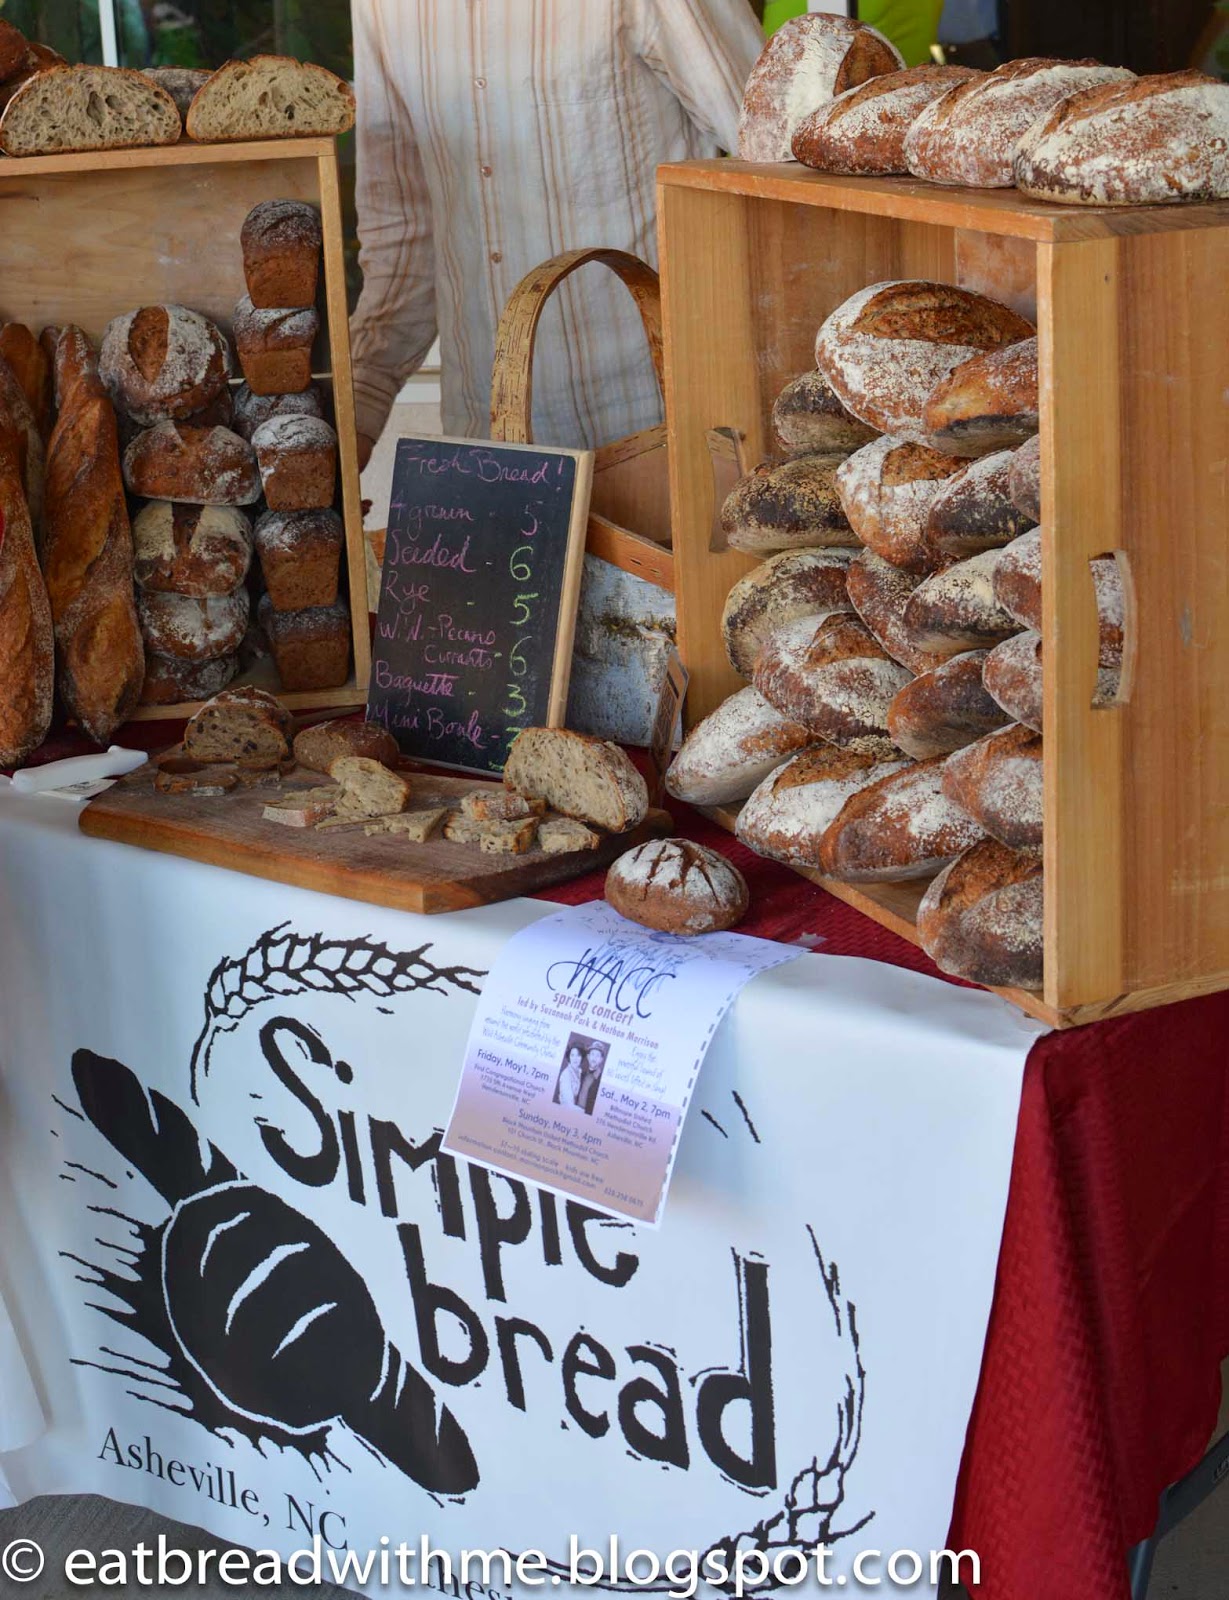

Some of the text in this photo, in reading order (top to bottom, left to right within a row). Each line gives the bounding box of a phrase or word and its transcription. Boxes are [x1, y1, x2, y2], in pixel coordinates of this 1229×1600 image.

[520, 501, 543, 536] 5
[389, 529, 477, 572] Seeded
[510, 546, 534, 581] 6
[386, 570, 430, 615] Rye
[510, 593, 539, 625] 5
[510, 636, 533, 676] 6
[375, 660, 460, 706] Baguette
[502, 683, 526, 717] 3
[547, 948, 676, 1018] WACC
[552, 991, 635, 1026] spring concert
[517, 996, 529, 1008] led
[573, 1010, 591, 1027] Park
[600, 1021, 627, 1040] Nathan
[626, 1028, 659, 1049] Morrison
[476, 1048, 504, 1066] Friday,
[530, 1066, 550, 1082] 7pm
[517, 1108, 552, 1129] Sunday,
[551, 1120, 571, 1136] May
[582, 1131, 603, 1147] 4pm
[619, 1093, 640, 1110] May
[649, 1104, 672, 1121] 7pm
[397, 1223, 777, 1492] bread
[97, 1427, 349, 1550] Asheville, NC
